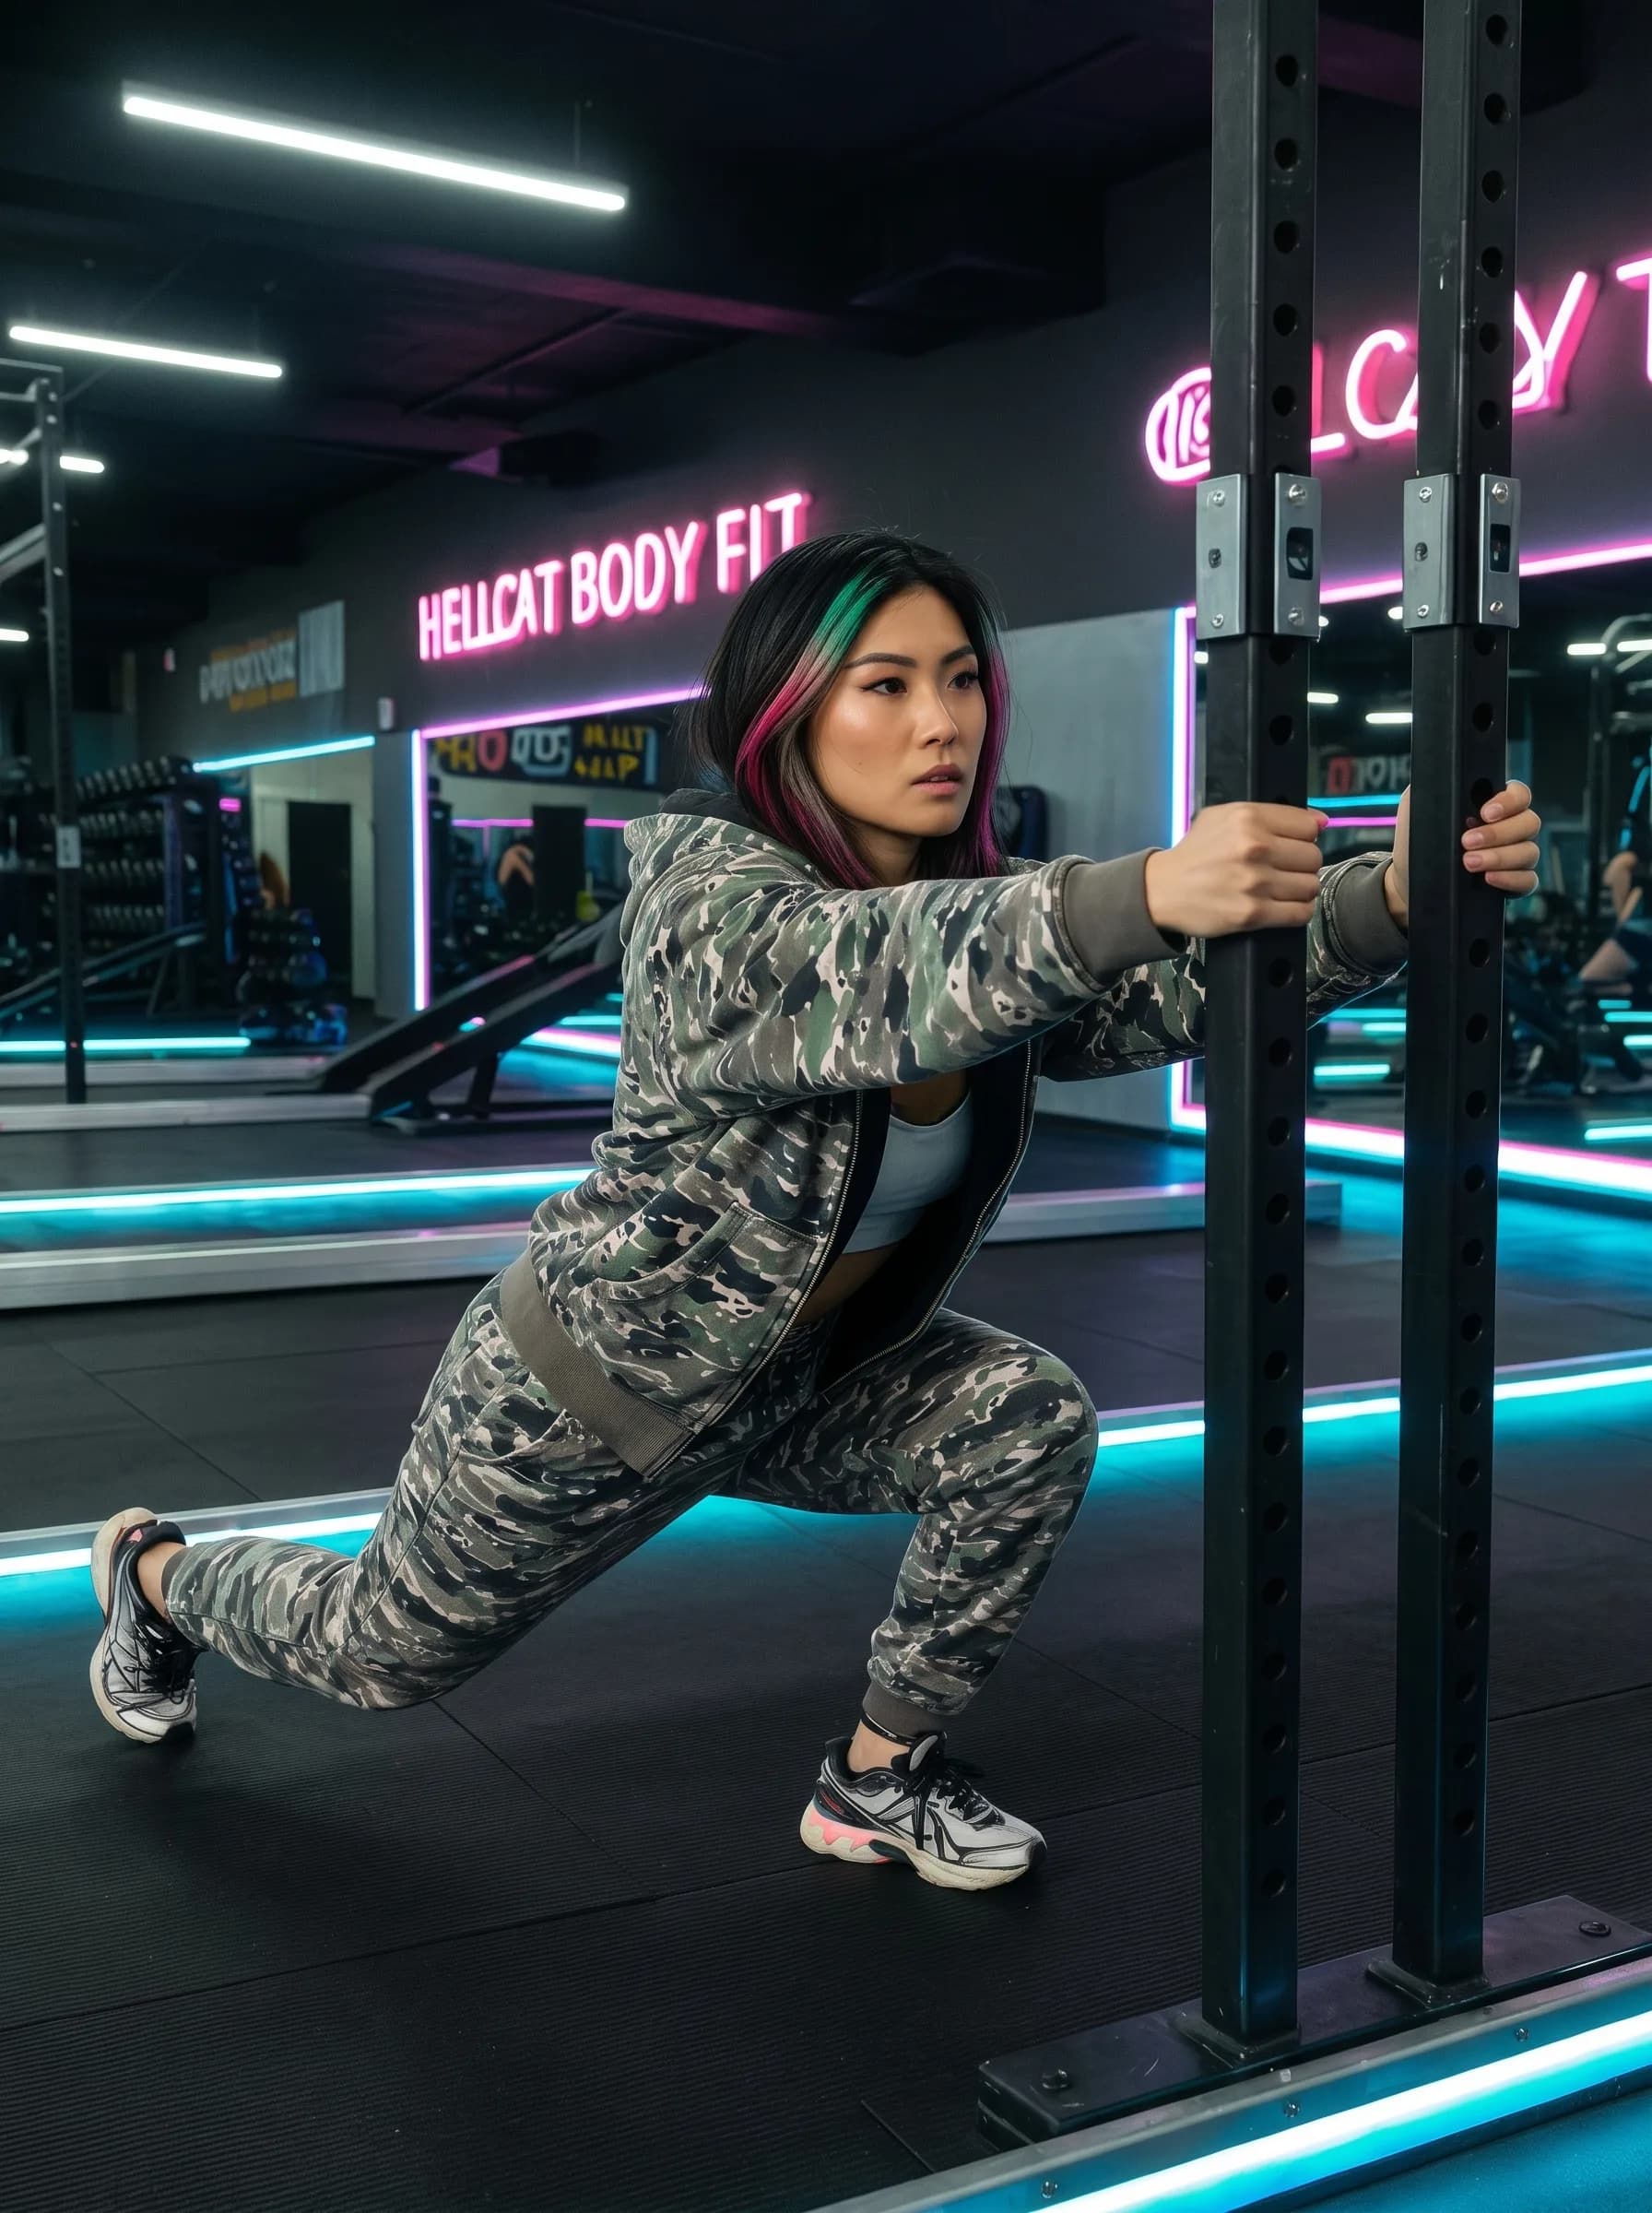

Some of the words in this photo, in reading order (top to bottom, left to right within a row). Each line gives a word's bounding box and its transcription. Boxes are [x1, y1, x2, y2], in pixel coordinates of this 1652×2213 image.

[419, 560, 563, 661] HELLCAT
[571, 520, 702, 626] BODY
[715, 491, 804, 593] FIT
